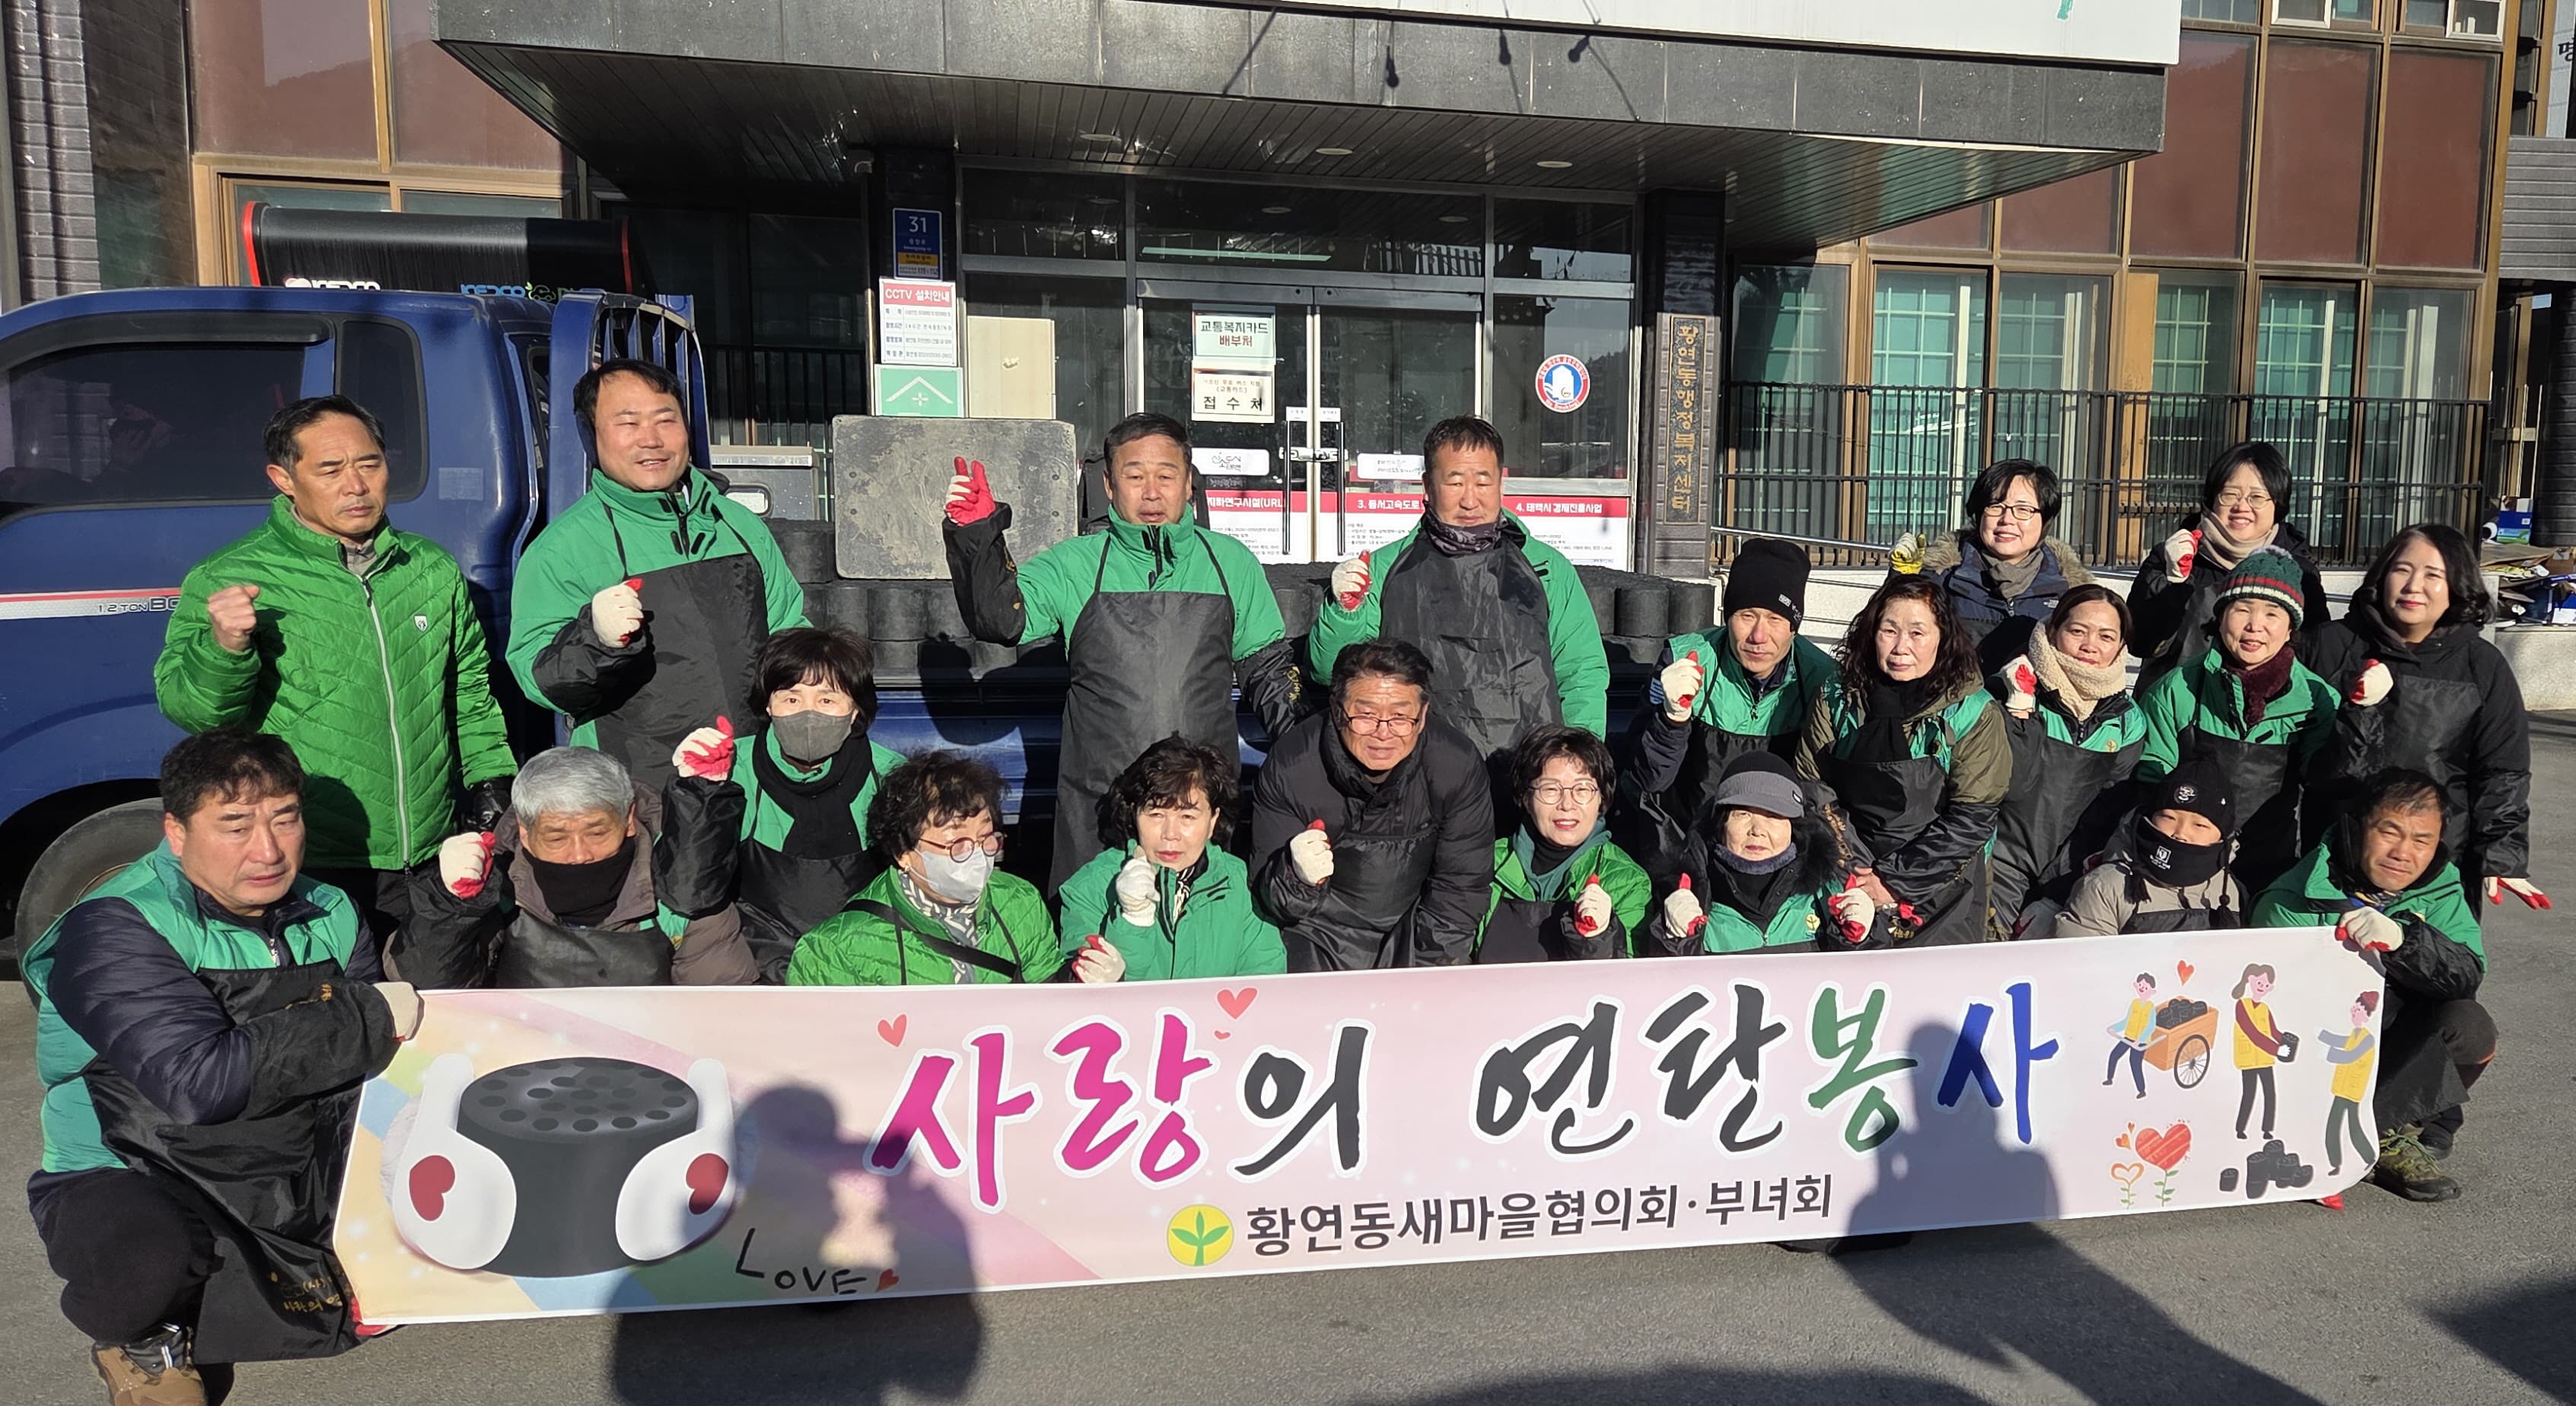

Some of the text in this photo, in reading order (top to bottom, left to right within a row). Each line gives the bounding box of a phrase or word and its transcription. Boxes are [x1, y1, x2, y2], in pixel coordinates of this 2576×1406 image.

[909, 216, 927, 233] 31
[885, 288, 950, 303] CCTV 설치안내
[1201, 320, 1269, 334] 교통복지카드
[1219, 335, 1253, 347] 배부처
[1671, 325, 1699, 515] 황연동행정복지센터
[1207, 497, 1286, 508] 지하연구시설(URL
[1358, 499, 1420, 510] 3. 동서고속도로
[1516, 503, 1525, 512] 4.
[1526, 502, 1552, 513] 태백시
[99, 604, 117, 612] 1.2
[870, 1013, 1370, 1208] 사랑의
